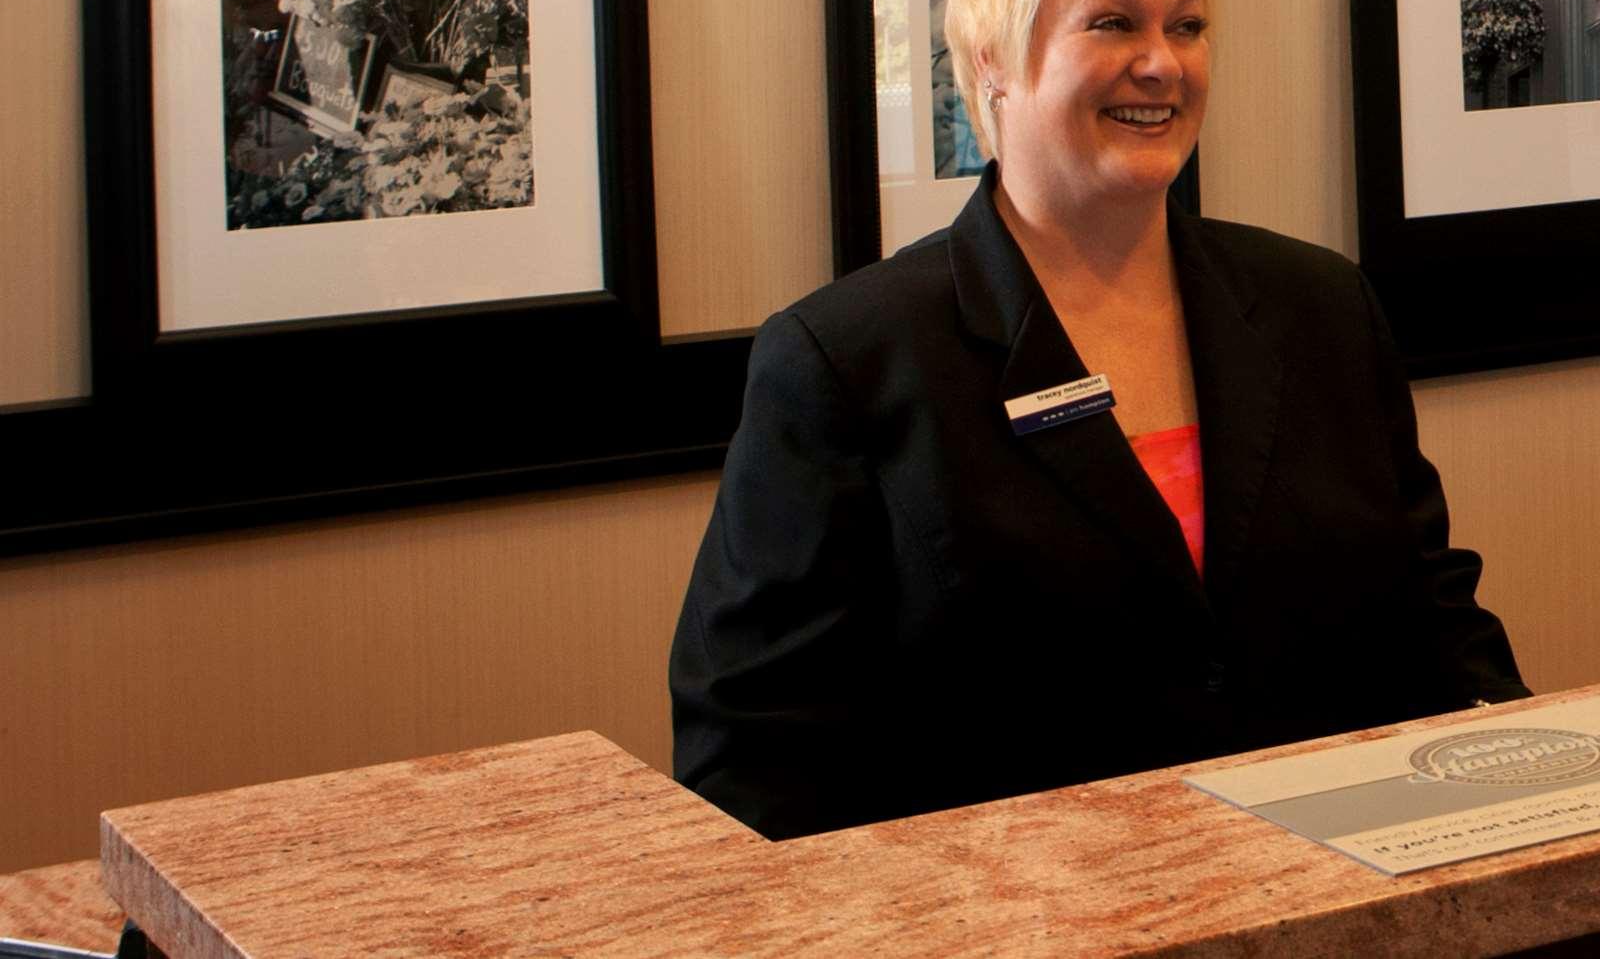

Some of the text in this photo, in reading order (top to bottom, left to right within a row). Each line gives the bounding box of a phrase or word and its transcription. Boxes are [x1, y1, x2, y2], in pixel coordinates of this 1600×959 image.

[1373, 846, 1391, 854] If
[1397, 832, 1463, 850] you're
[1468, 823, 1504, 834] not
[1508, 803, 1599, 826] satisfied,
